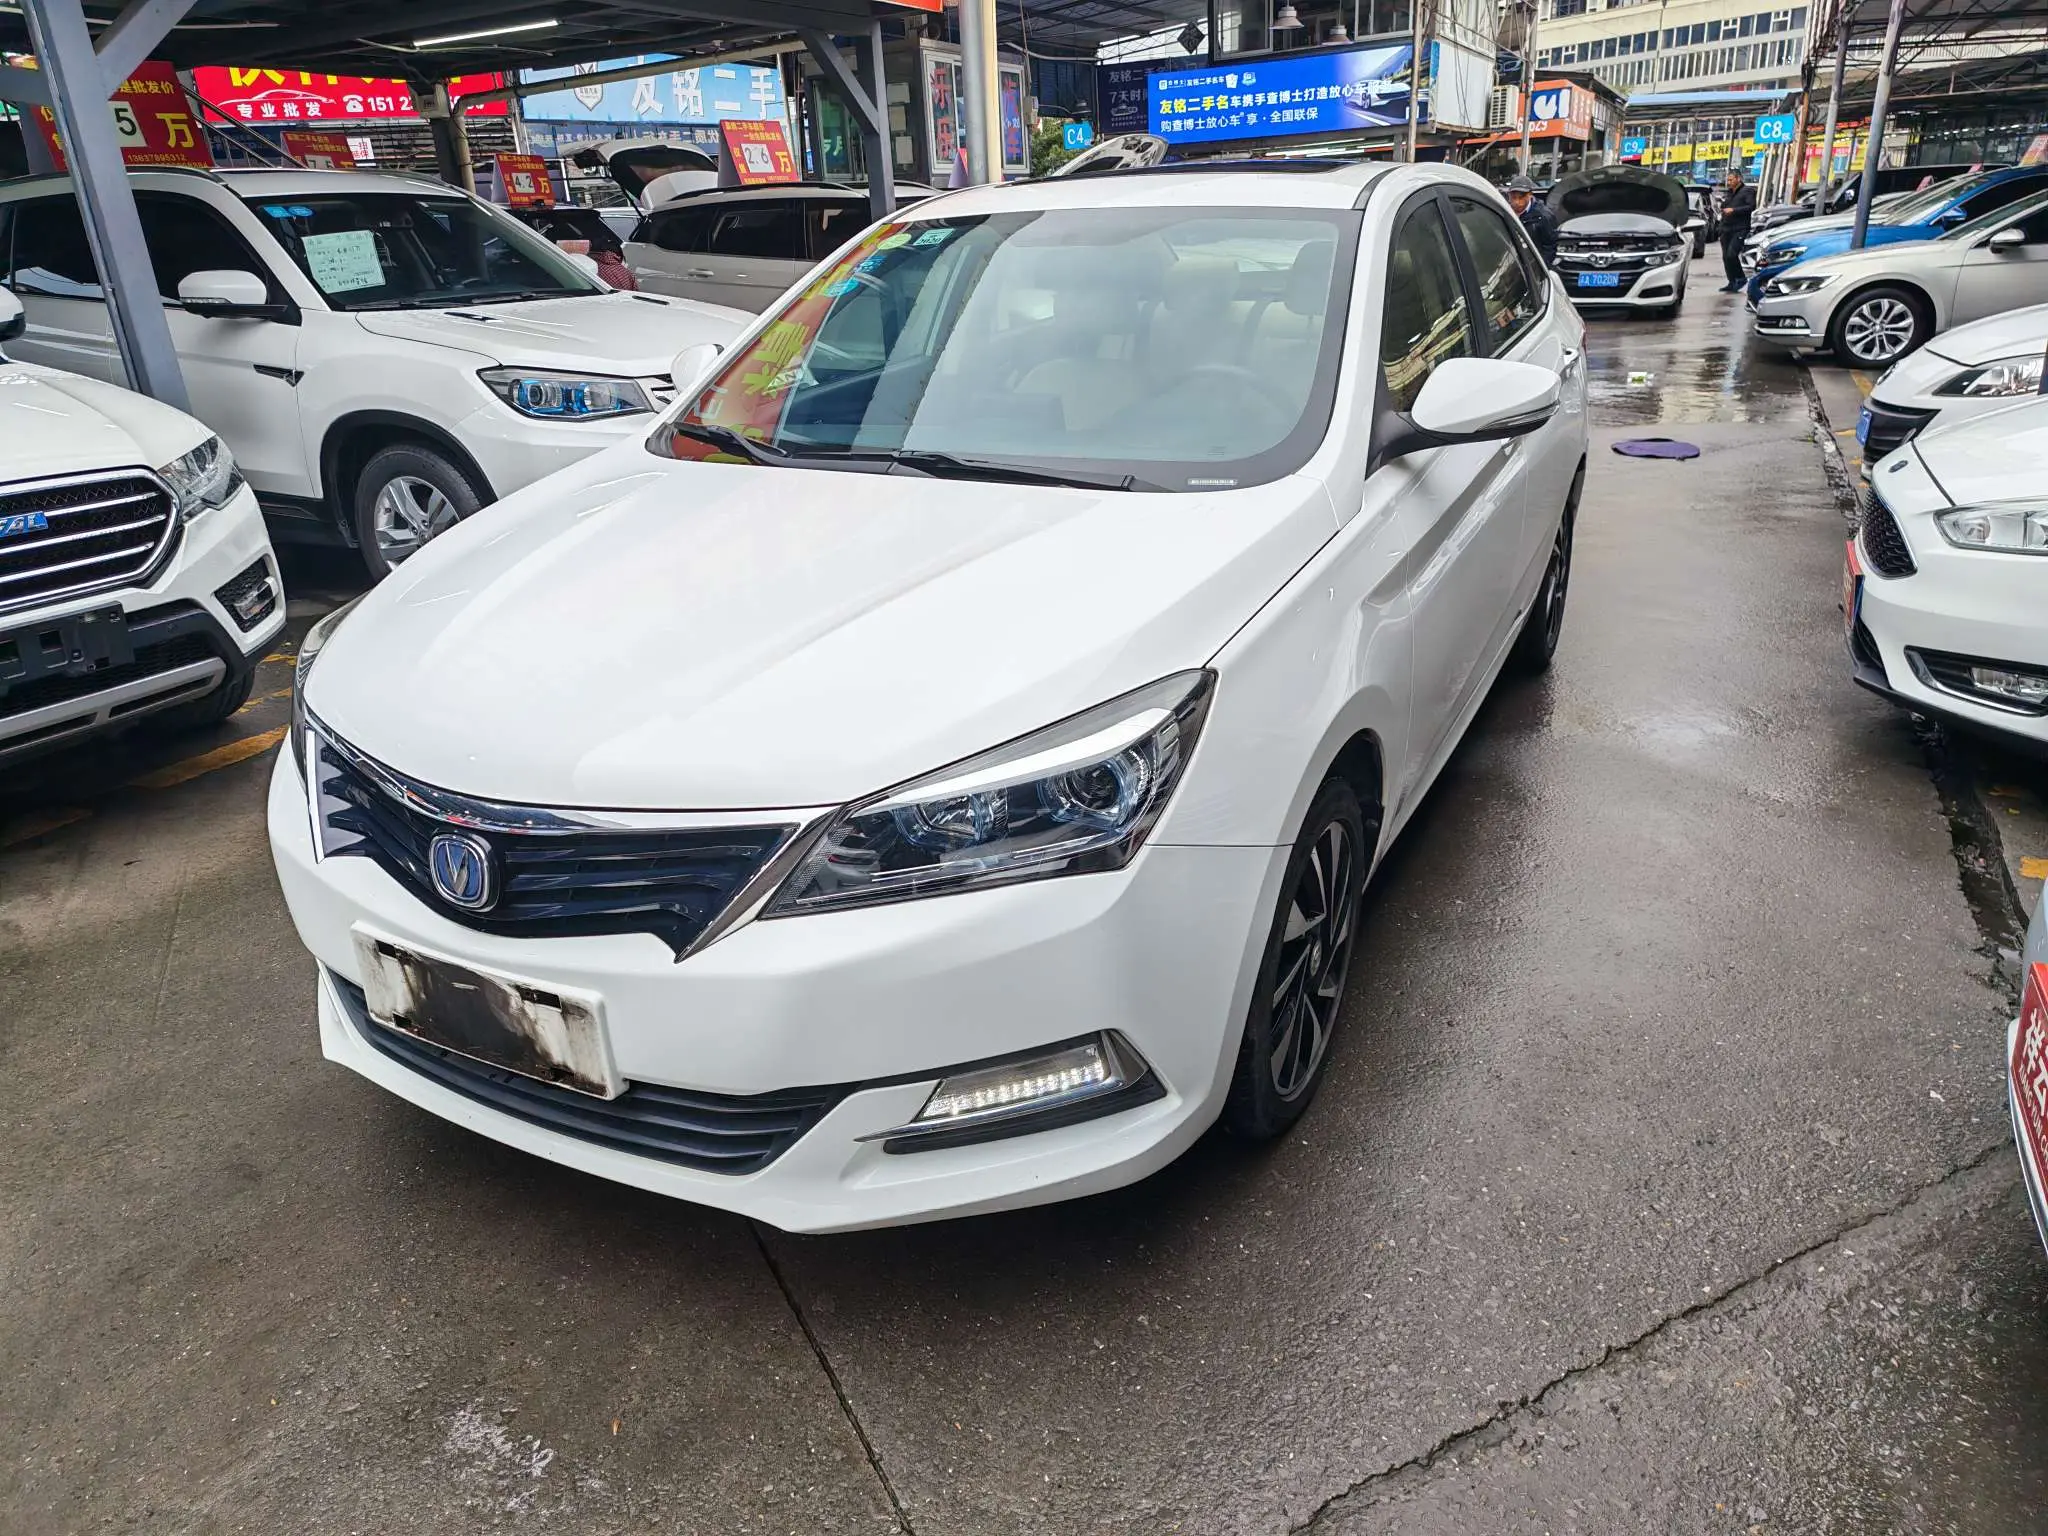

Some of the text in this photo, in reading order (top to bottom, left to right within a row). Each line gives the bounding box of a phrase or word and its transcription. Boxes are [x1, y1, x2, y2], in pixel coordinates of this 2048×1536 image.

[236, 102, 322, 119] 专业批发
[367, 96, 394, 112] 151
[114, 107, 137, 136] 5
[154, 112, 195, 149] 万
[744, 147, 792, 173] 2.6 万
